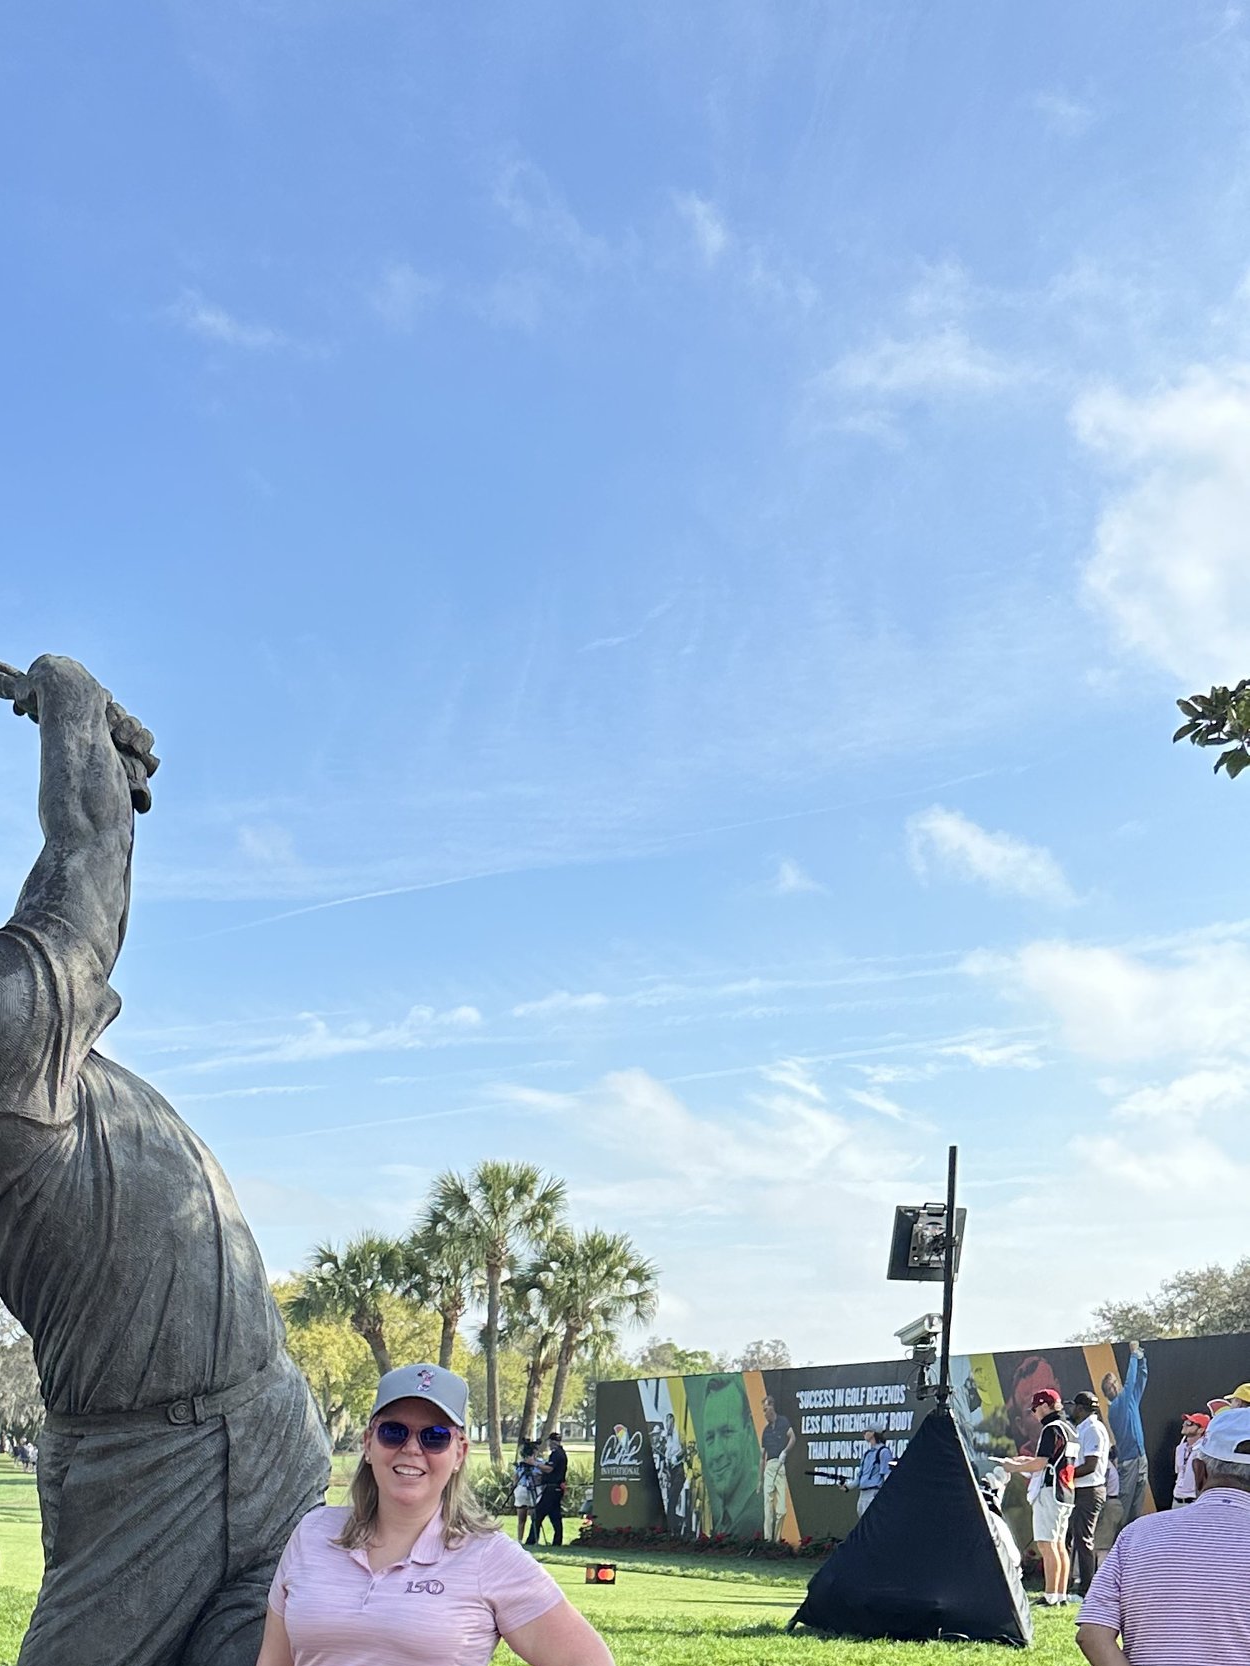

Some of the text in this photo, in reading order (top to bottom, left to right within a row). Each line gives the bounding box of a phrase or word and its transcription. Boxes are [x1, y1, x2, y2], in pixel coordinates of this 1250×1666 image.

[834, 1388, 845, 1407] IN
[845, 1387, 866, 1406] GOLF
[866, 1384, 906, 1405] DEPENDS
[801, 1415, 820, 1434] LESS
[821, 1414, 833, 1433] ON
[889, 1411, 914, 1431] BODY
[807, 1442, 829, 1459] THAN
[830, 1441, 852, 1459] UPON
